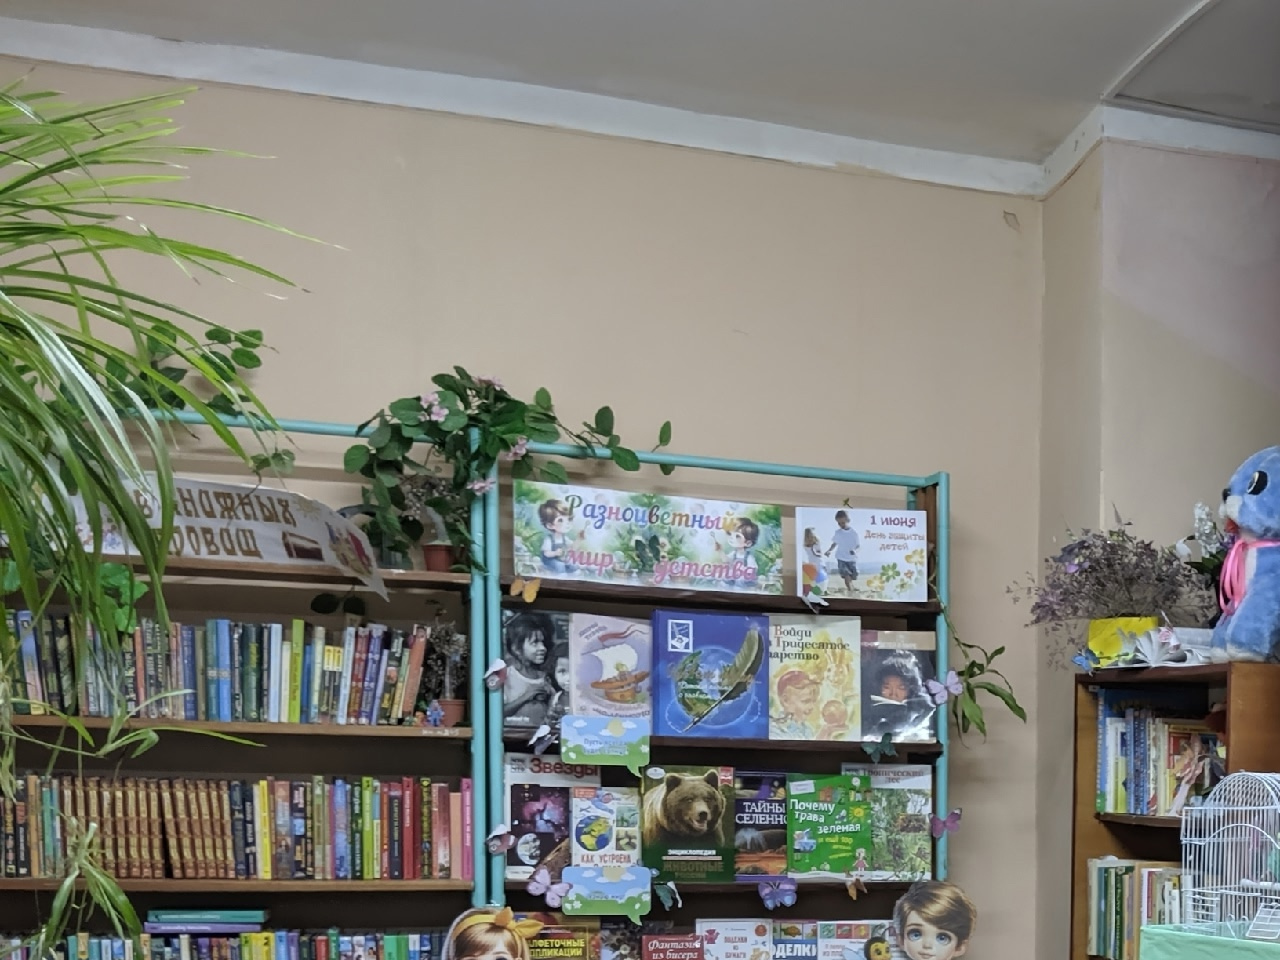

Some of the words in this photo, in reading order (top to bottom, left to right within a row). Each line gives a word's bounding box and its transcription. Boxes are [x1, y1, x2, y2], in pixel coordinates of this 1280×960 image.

[565, 494, 737, 530] Разноцветный
[870, 515, 877, 525] 1
[881, 517, 916, 528] июня
[864, 530, 886, 540] День
[880, 542, 909, 551] детей
[565, 549, 614, 570] мир
[654, 559, 757, 584] детства
[773, 624, 812, 640] Войди
[776, 637, 850, 652] Тридесятое
[530, 757, 598, 777] Звезды
[743, 801, 786, 814] ТАЙНЫ
[789, 799, 835, 814] Почему
[794, 812, 824, 824] трава
[817, 824, 861, 834] зеленая
[581, 854, 594, 864] КАК
[599, 853, 632, 864] УСТРОЕНА
[663, 861, 724, 872] ЖИВОТНЫЕ
[653, 951, 664, 959] из
